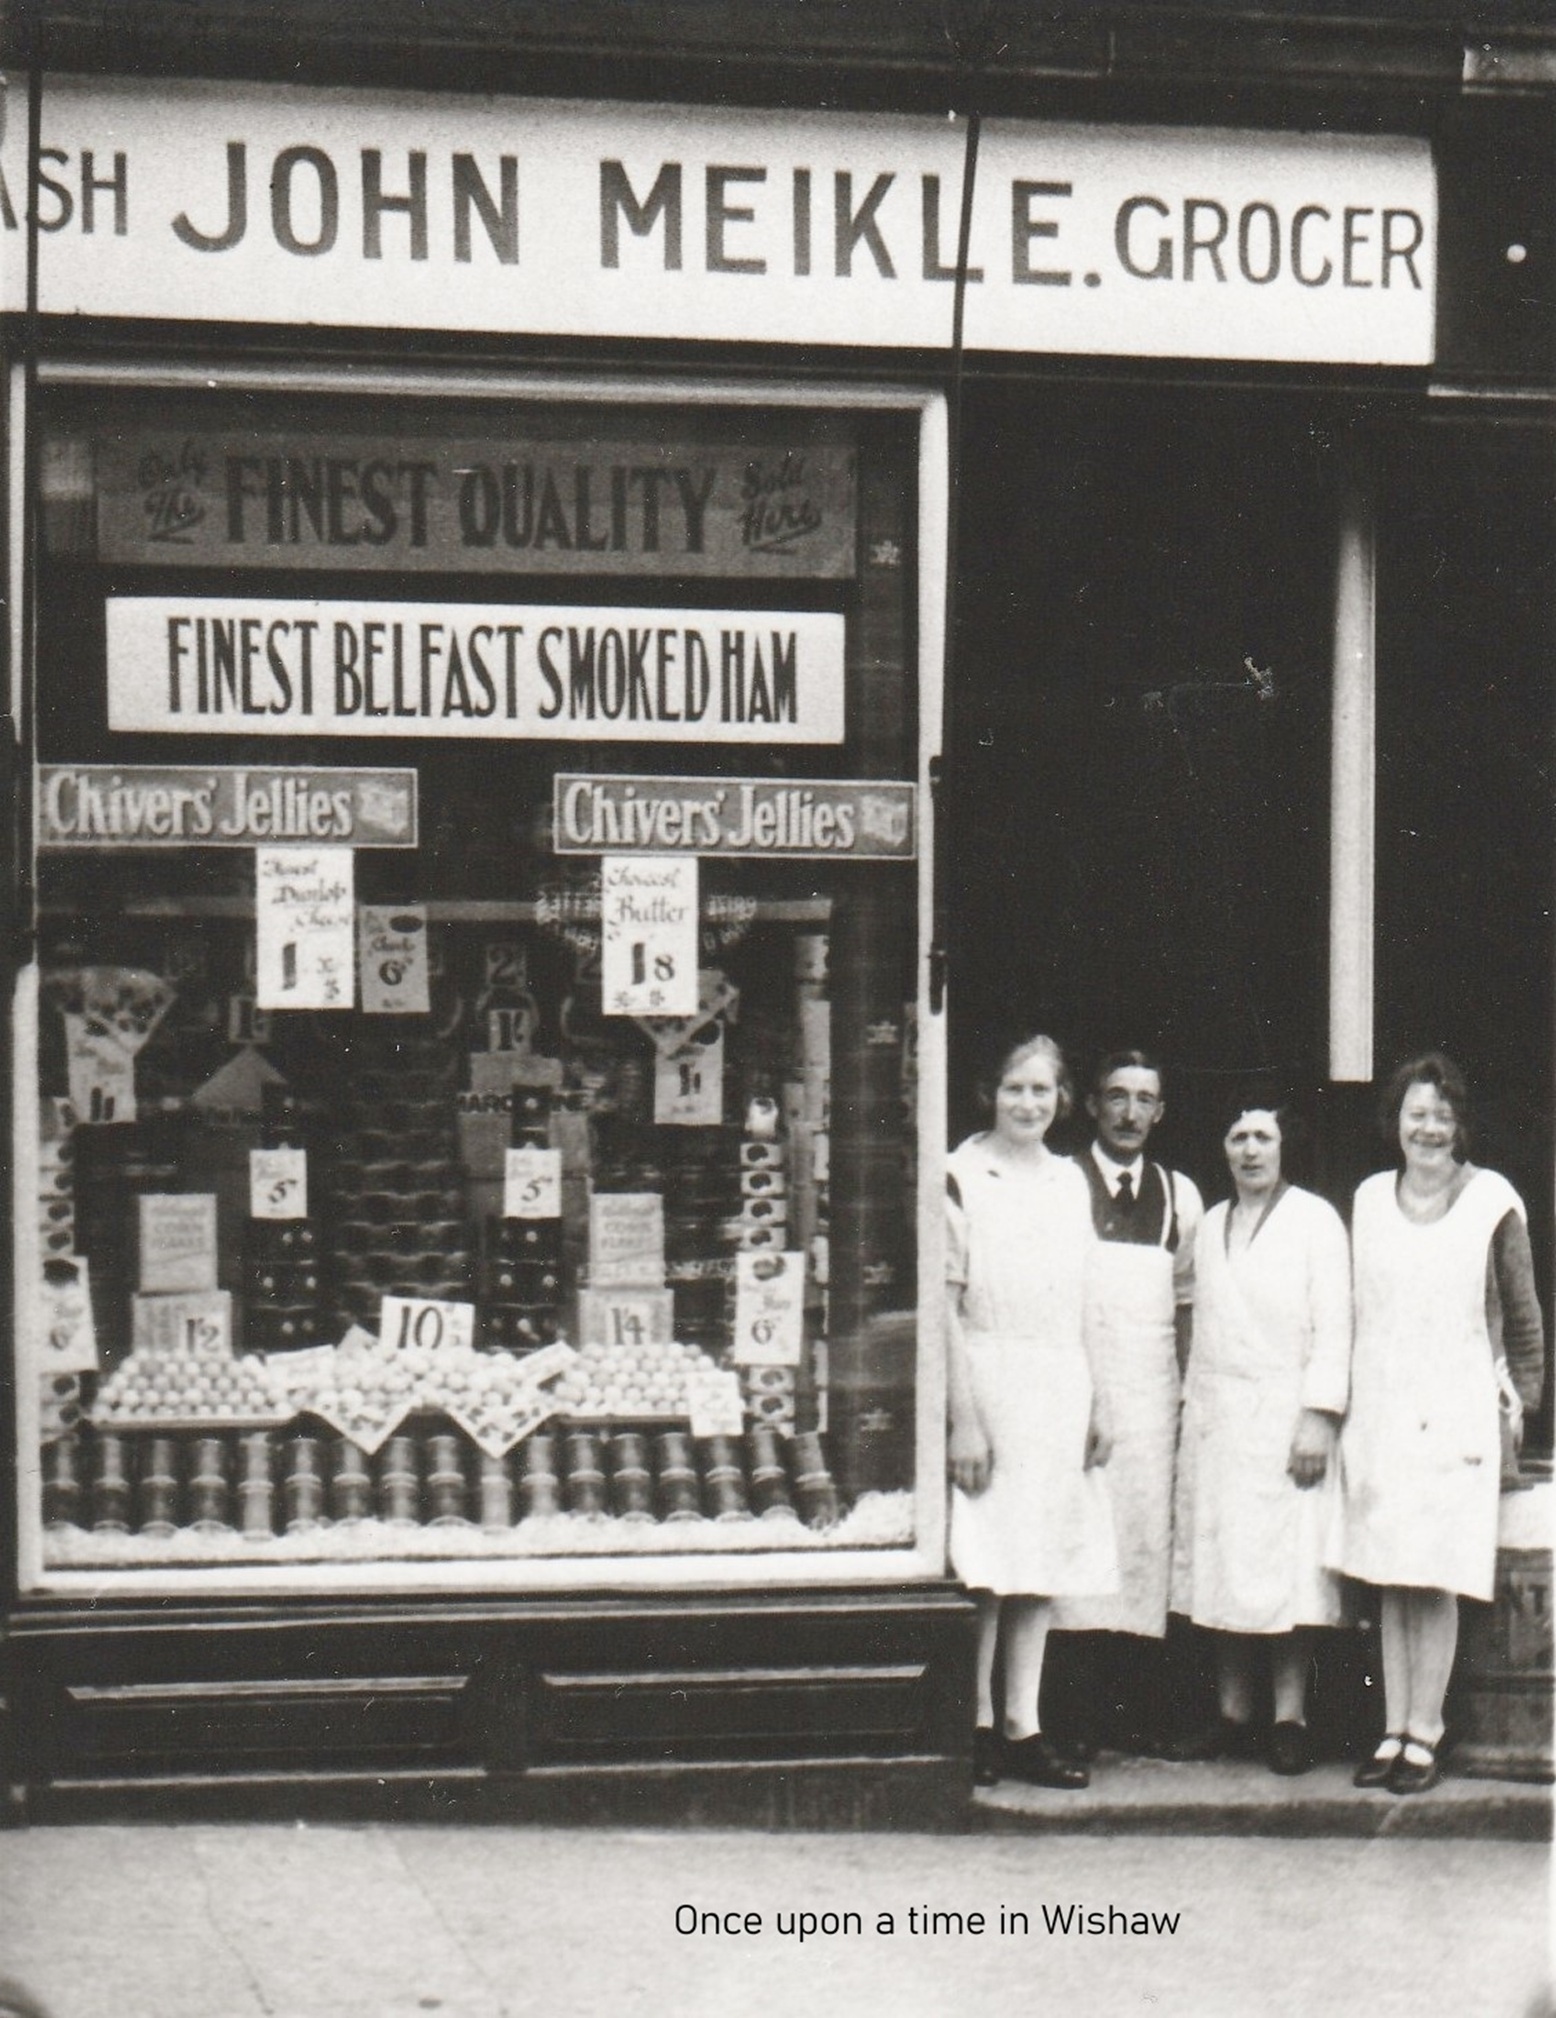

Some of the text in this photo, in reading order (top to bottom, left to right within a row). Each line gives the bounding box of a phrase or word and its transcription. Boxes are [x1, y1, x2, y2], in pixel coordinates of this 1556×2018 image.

[171, 141, 520, 264] JOHN
[599, 159, 1102, 288] MEIKLE.
[1114, 196, 1424, 291] GROCER
[226, 457, 718, 553] FINEST QUALITY
[167, 616, 798, 724] FINEST BELFAST SMOKED HAM
[220, 769, 354, 837] Jellies
[727, 784, 856, 850] Jellies
[615, 893, 690, 923] Butter
[397, 1305, 444, 1350] 10
